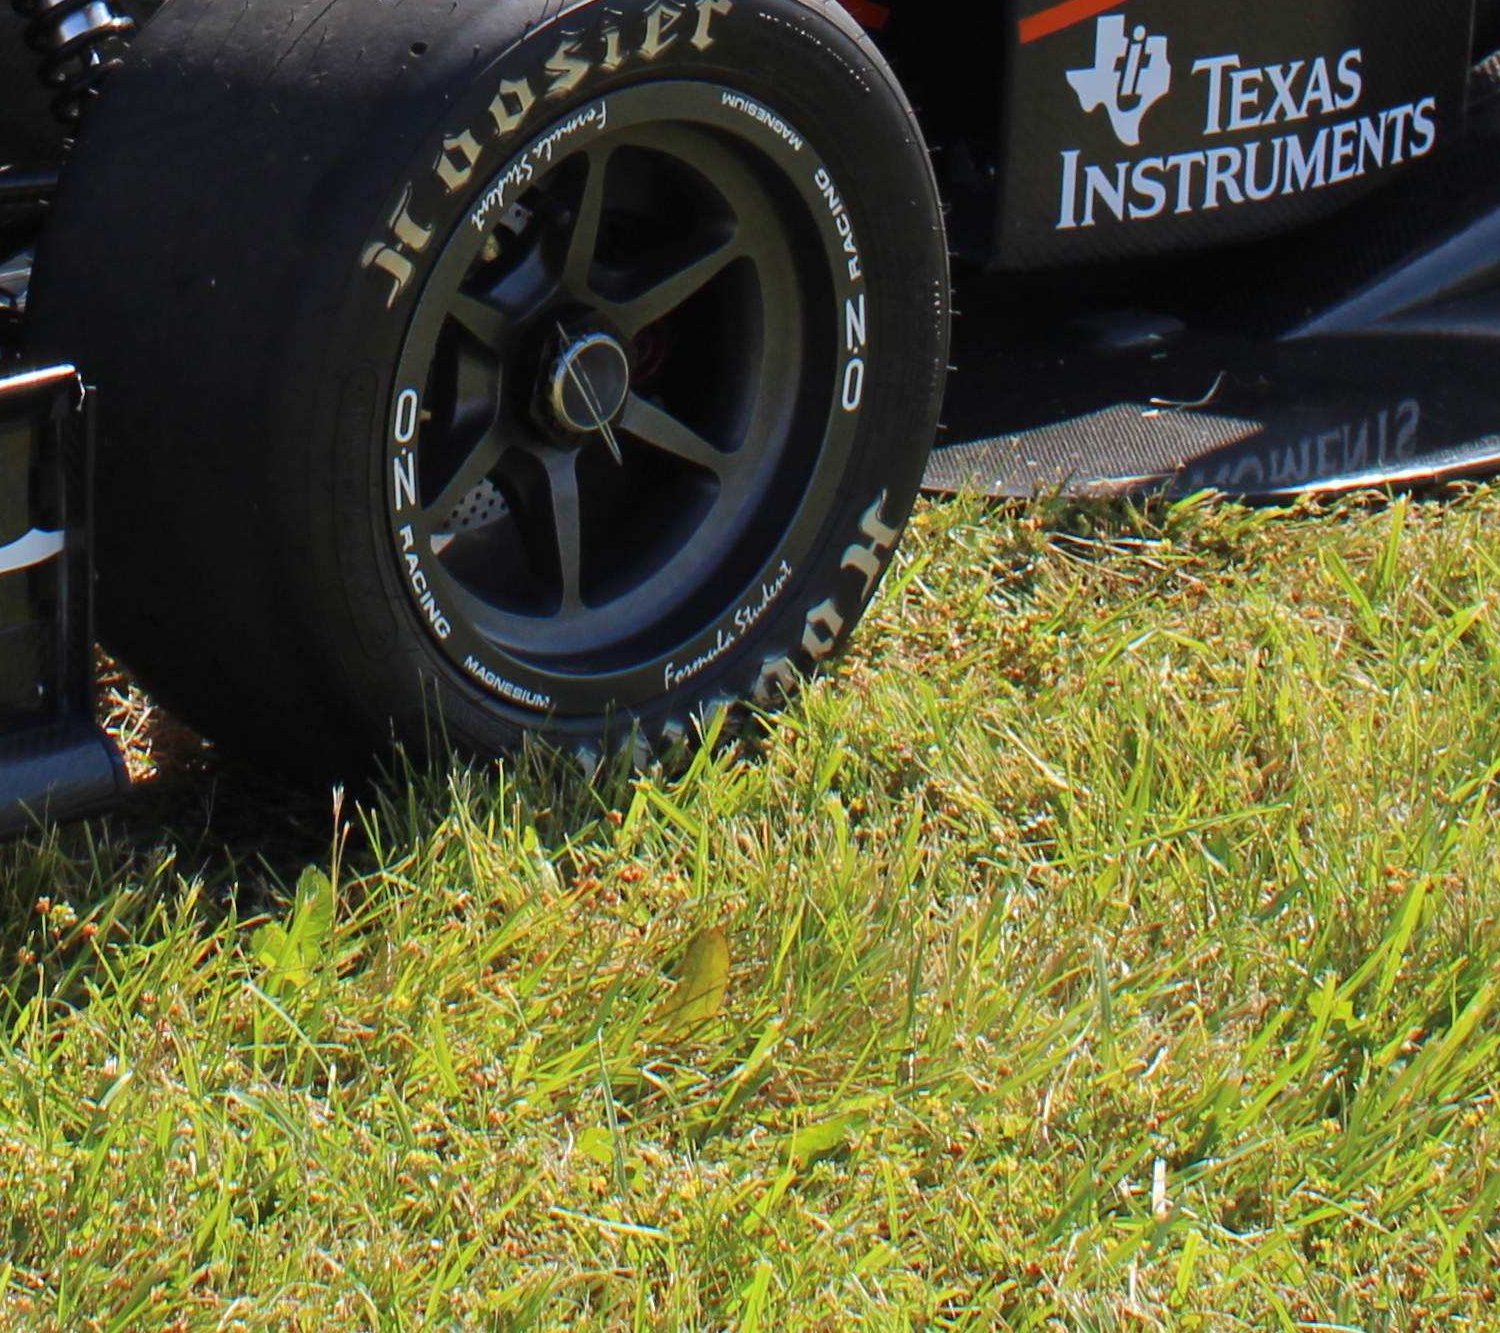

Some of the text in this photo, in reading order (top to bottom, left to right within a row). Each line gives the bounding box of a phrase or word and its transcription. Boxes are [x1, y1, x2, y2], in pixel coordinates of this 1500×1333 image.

[721, 92, 803, 151] MAGNESIUM
[1191, 49, 1362, 135] TEXAS
[471, 100, 608, 232] Formula Student
[1056, 98, 1435, 230] INSTRUMENTS
[814, 168, 864, 281] RACING
[399, 524, 451, 640] RACING
[664, 559, 793, 690] Formula Student
[464, 655, 551, 710] MAGNESIUM
